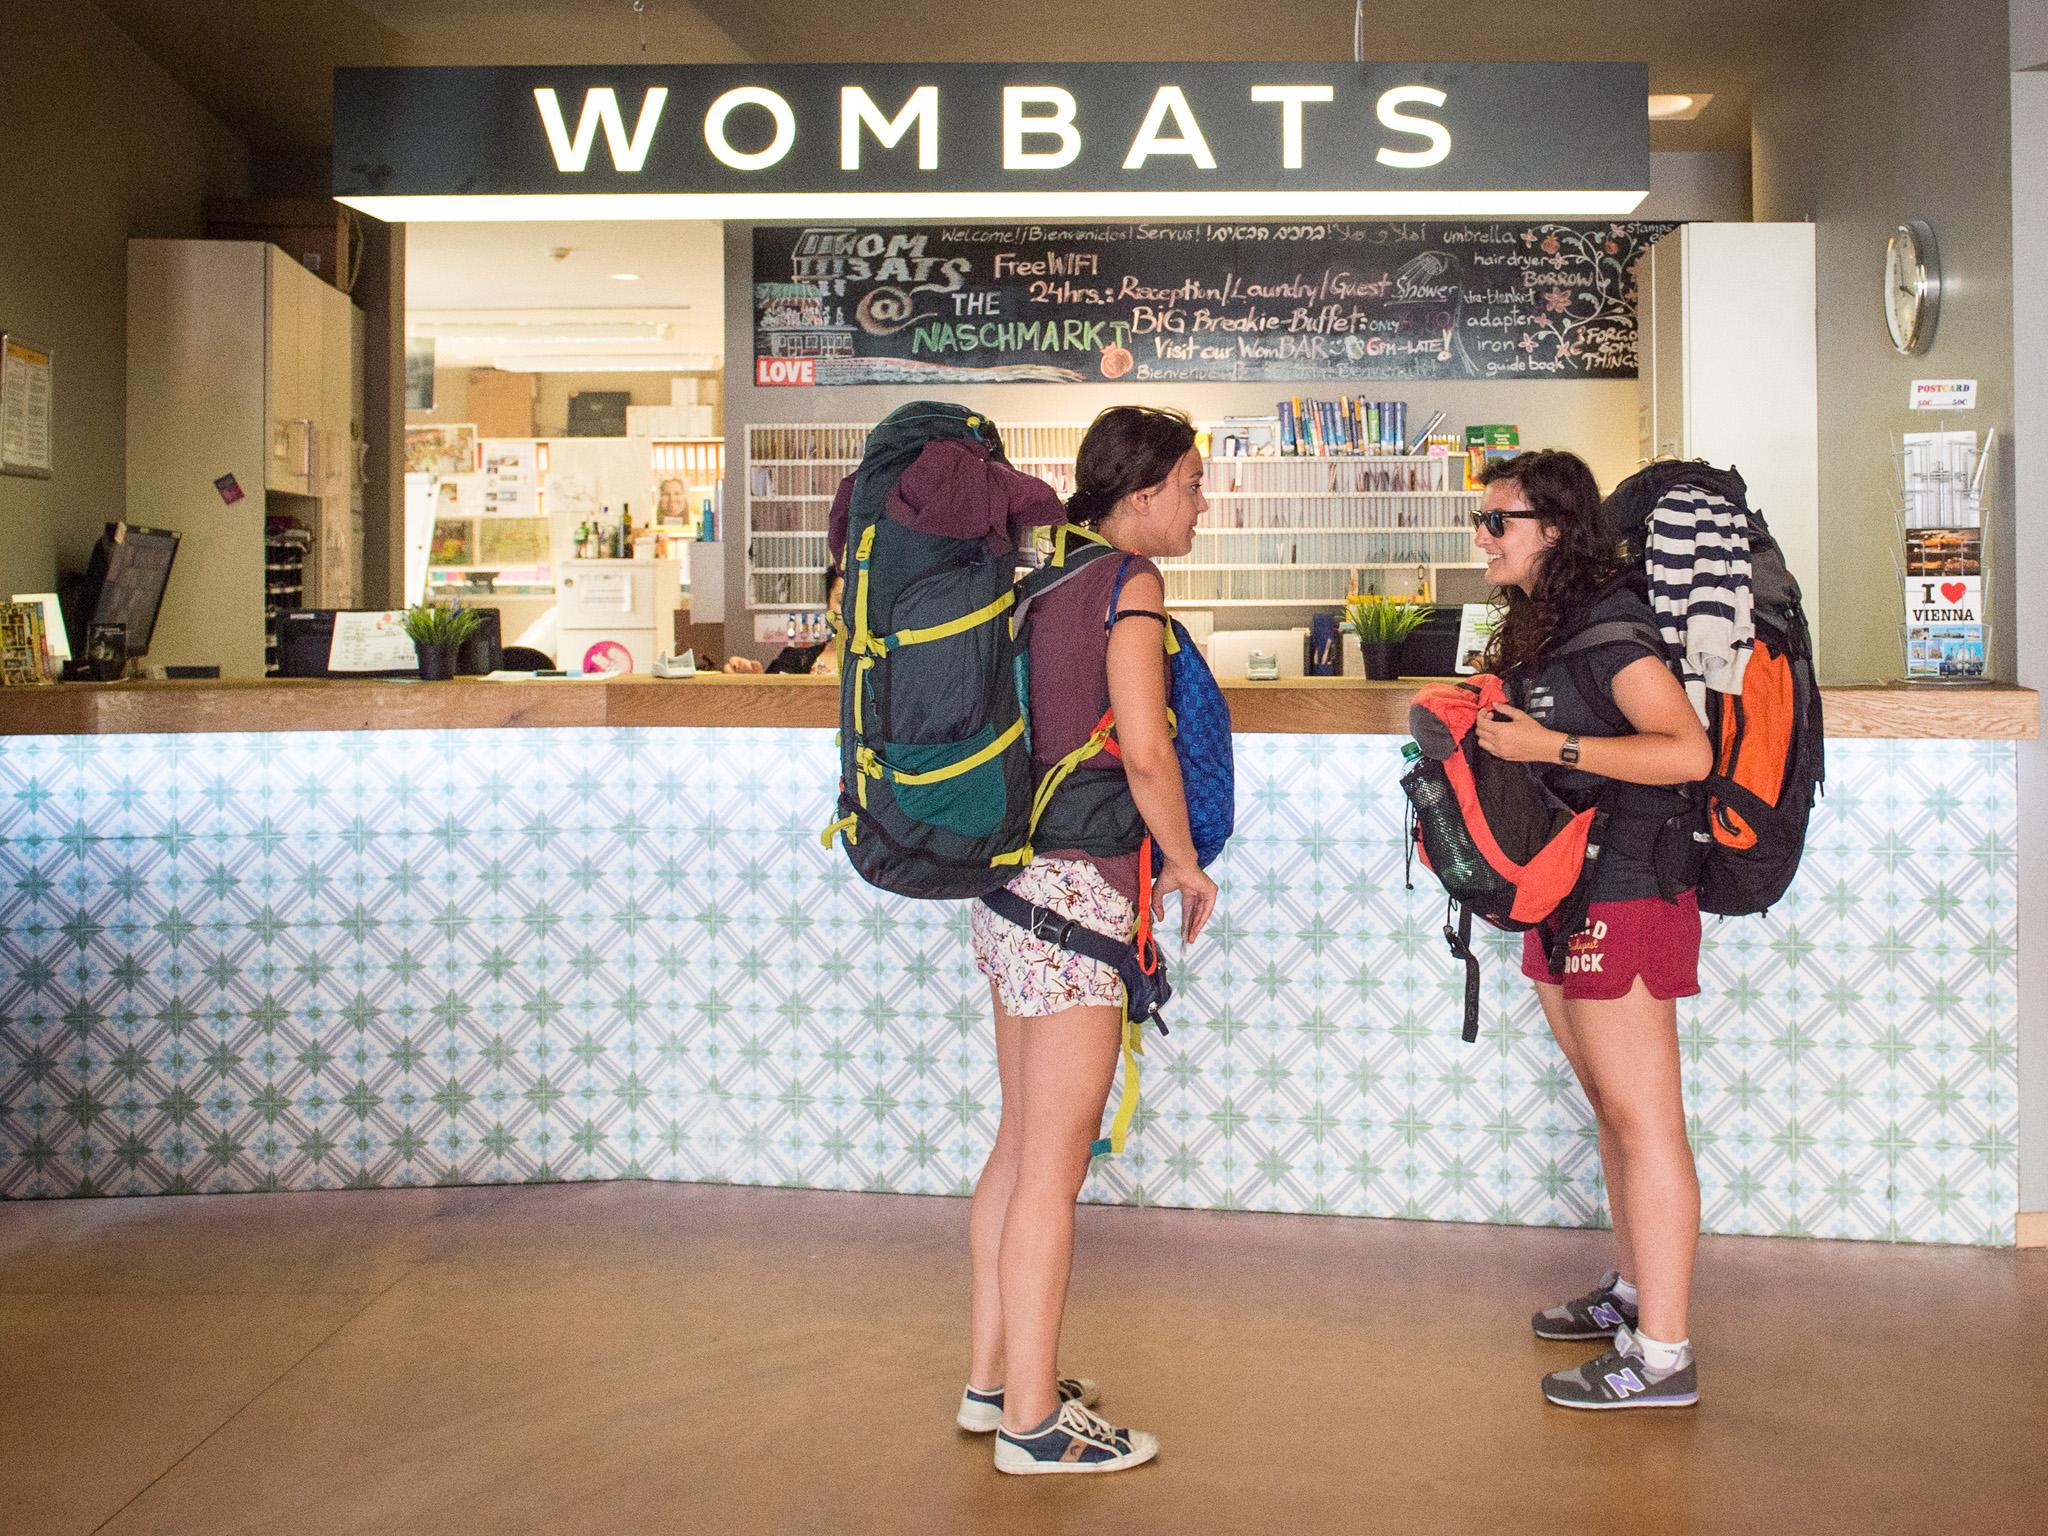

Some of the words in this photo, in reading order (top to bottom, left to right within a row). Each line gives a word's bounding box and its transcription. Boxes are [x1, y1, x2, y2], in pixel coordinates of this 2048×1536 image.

[533, 84, 1453, 173] WOMBATS
[1443, 223, 1517, 244] umbrella
[1511, 250, 1550, 271] dryer
[952, 291, 1000, 317] THE
[1466, 306, 1534, 333] adapter
[911, 318, 1133, 355] NASCHMARKT
[1154, 335, 1200, 360] Visit
[1477, 335, 1515, 351] iron
[758, 360, 813, 384] LOVE
[1486, 356, 1525, 376] guide
[1528, 356, 1564, 372] book
[1916, 384, 1970, 393] POSTCARD
[1921, 583, 1935, 604] I
[1912, 609, 1975, 622] VIENNA
[1588, 1302, 1624, 1329] N
[1604, 1367, 1646, 1399] N
